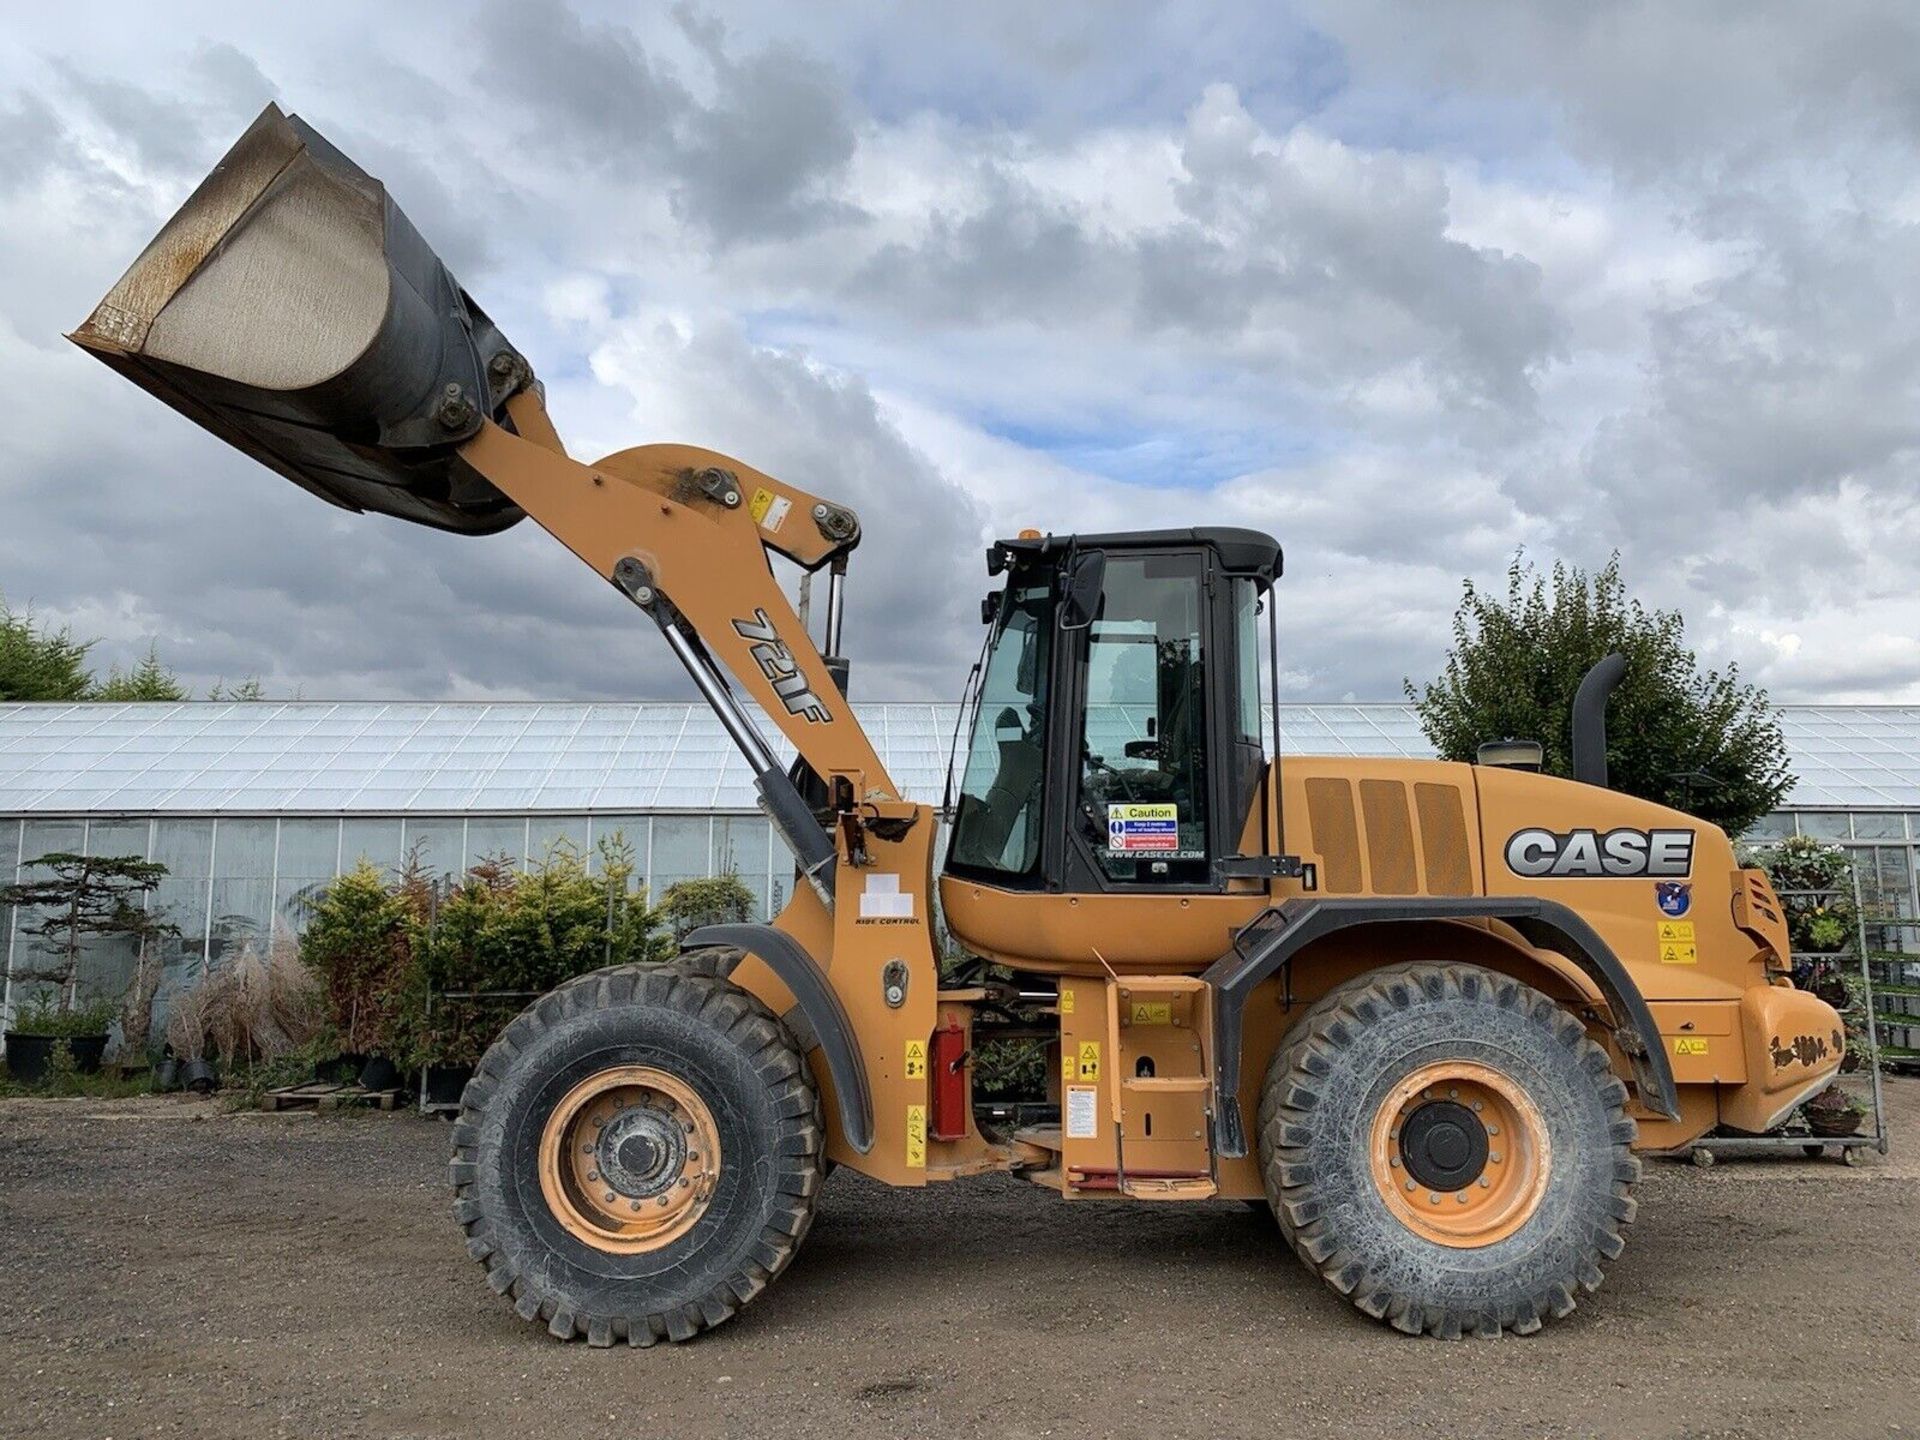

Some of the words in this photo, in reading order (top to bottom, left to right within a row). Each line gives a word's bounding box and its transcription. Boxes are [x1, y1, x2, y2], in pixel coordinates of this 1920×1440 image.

[731, 608, 834, 722] 721F
[1129, 808, 1171, 818] Caution
[1507, 831, 1693, 876] CASE
